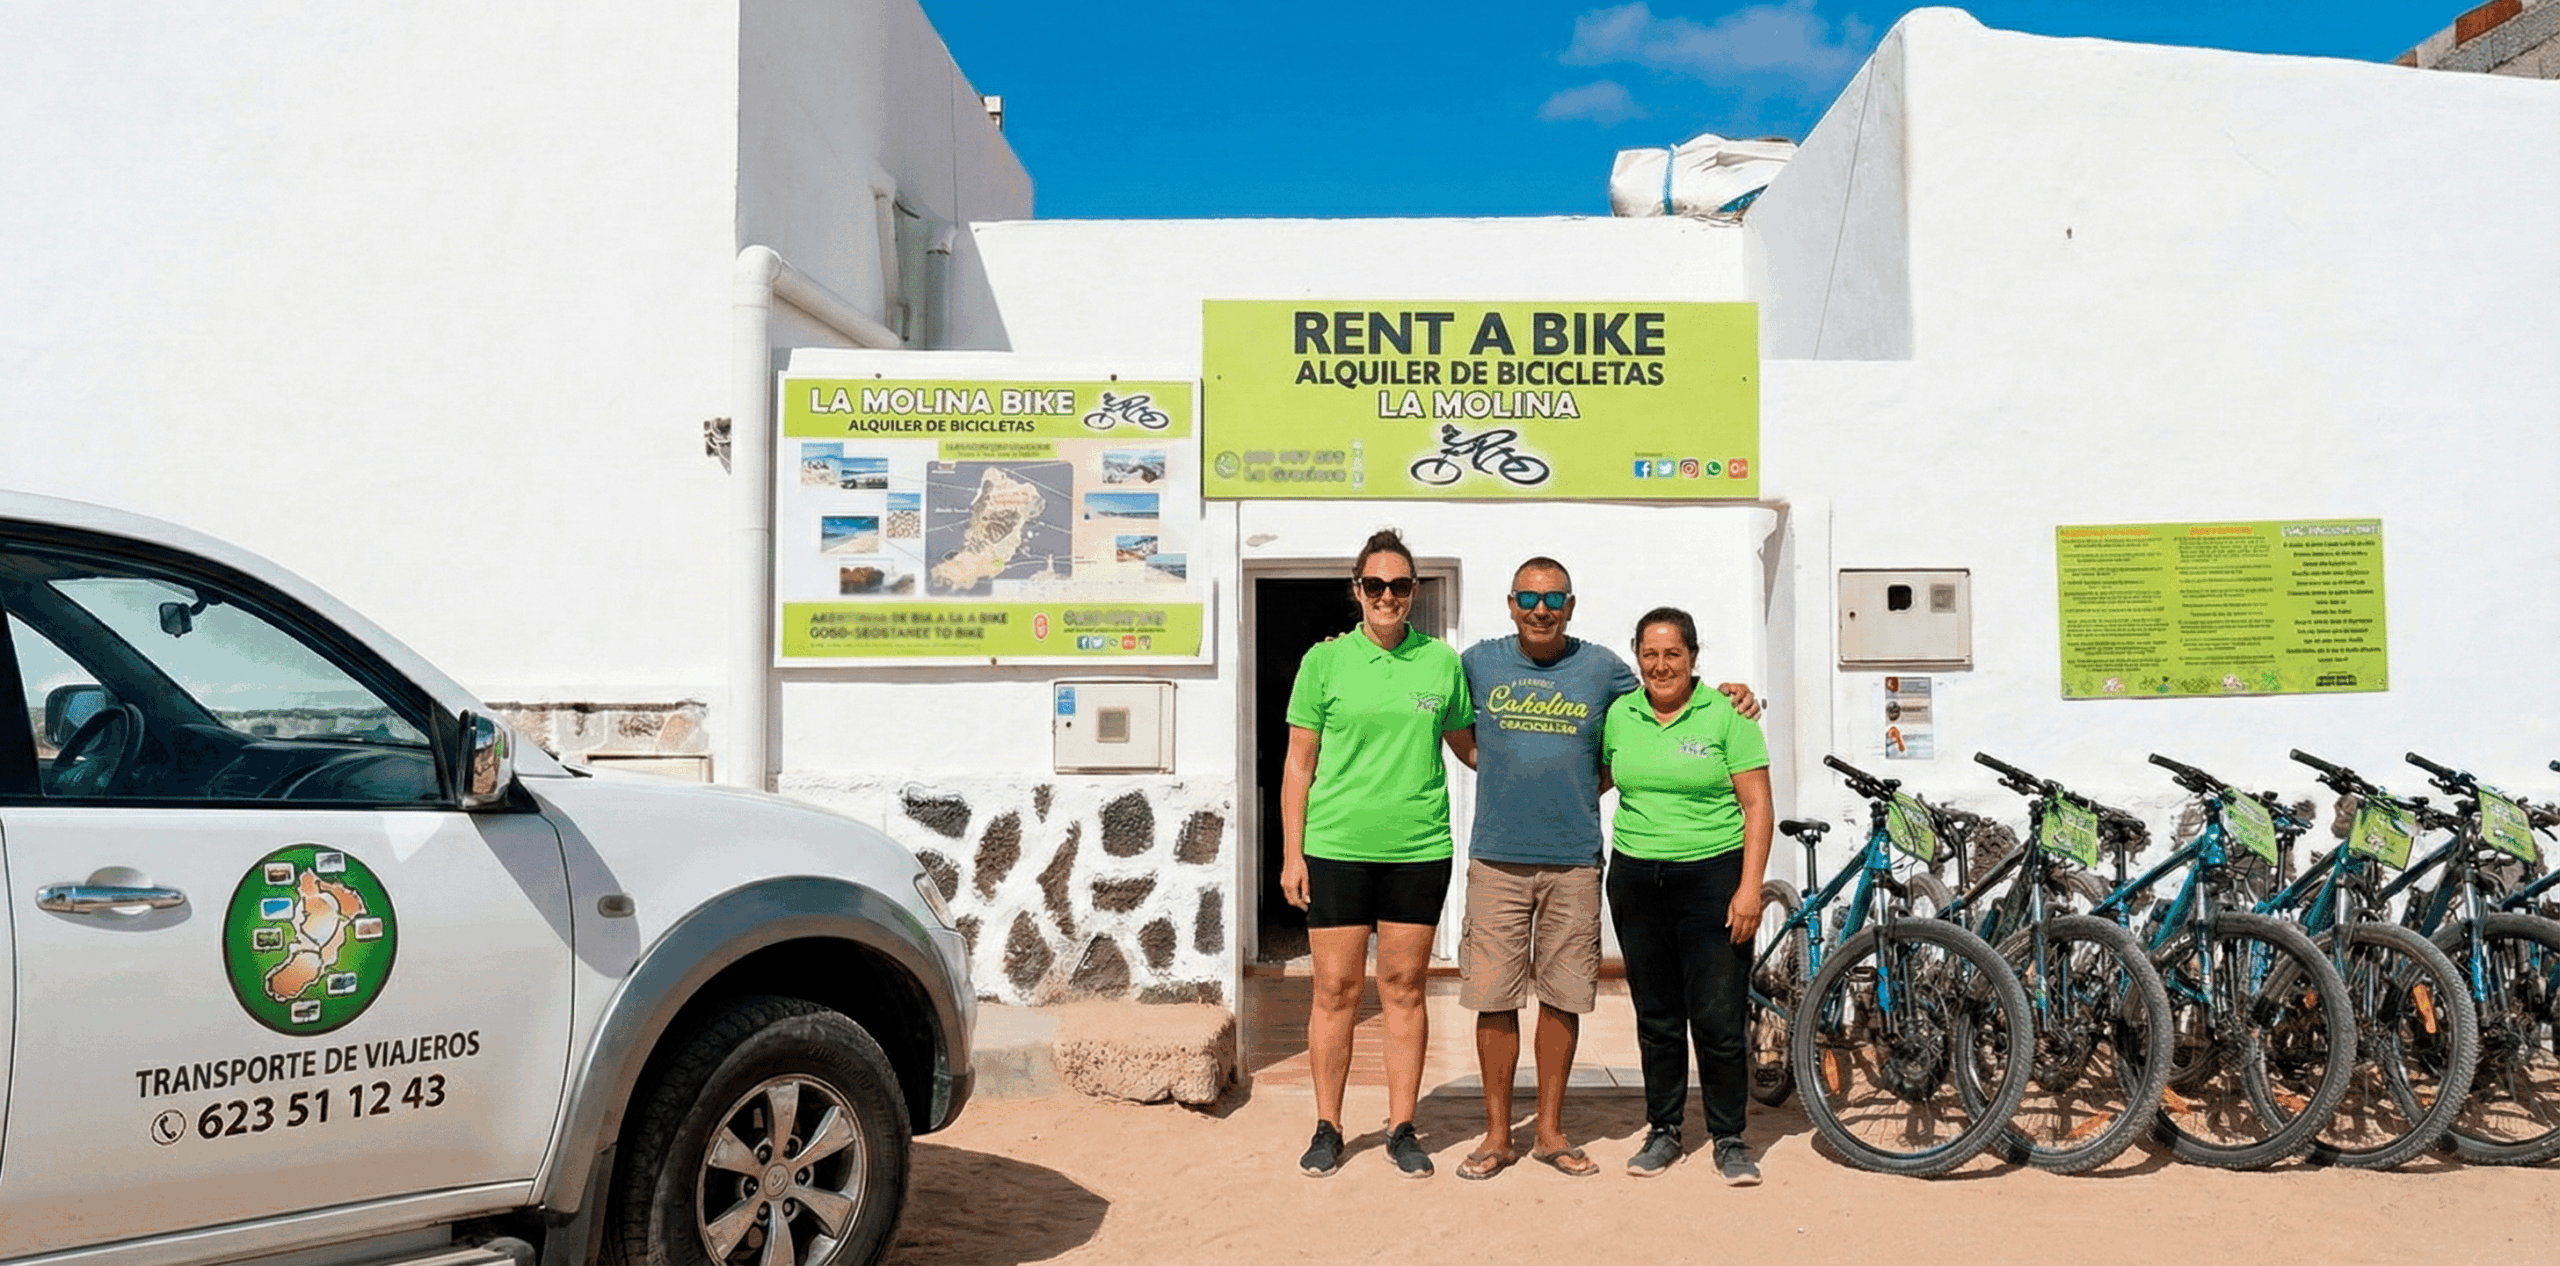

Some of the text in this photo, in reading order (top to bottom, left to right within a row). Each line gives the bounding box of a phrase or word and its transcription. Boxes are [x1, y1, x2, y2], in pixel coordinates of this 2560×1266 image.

[1293, 310, 1666, 356] RENT A BIKE
[1295, 360, 1665, 389] ALQUILER DE BICICLETAS
[809, 387, 1075, 417] LA MOLINA BIKE
[1378, 390, 1581, 420] LA MOLINA
[848, 419, 1035, 433] ALQUILER DE BICICLETAS
[136, 1030, 481, 1098] TRANSPORTE DE VIAJEROS
[196, 1073, 448, 1140] 623 51 12 43
